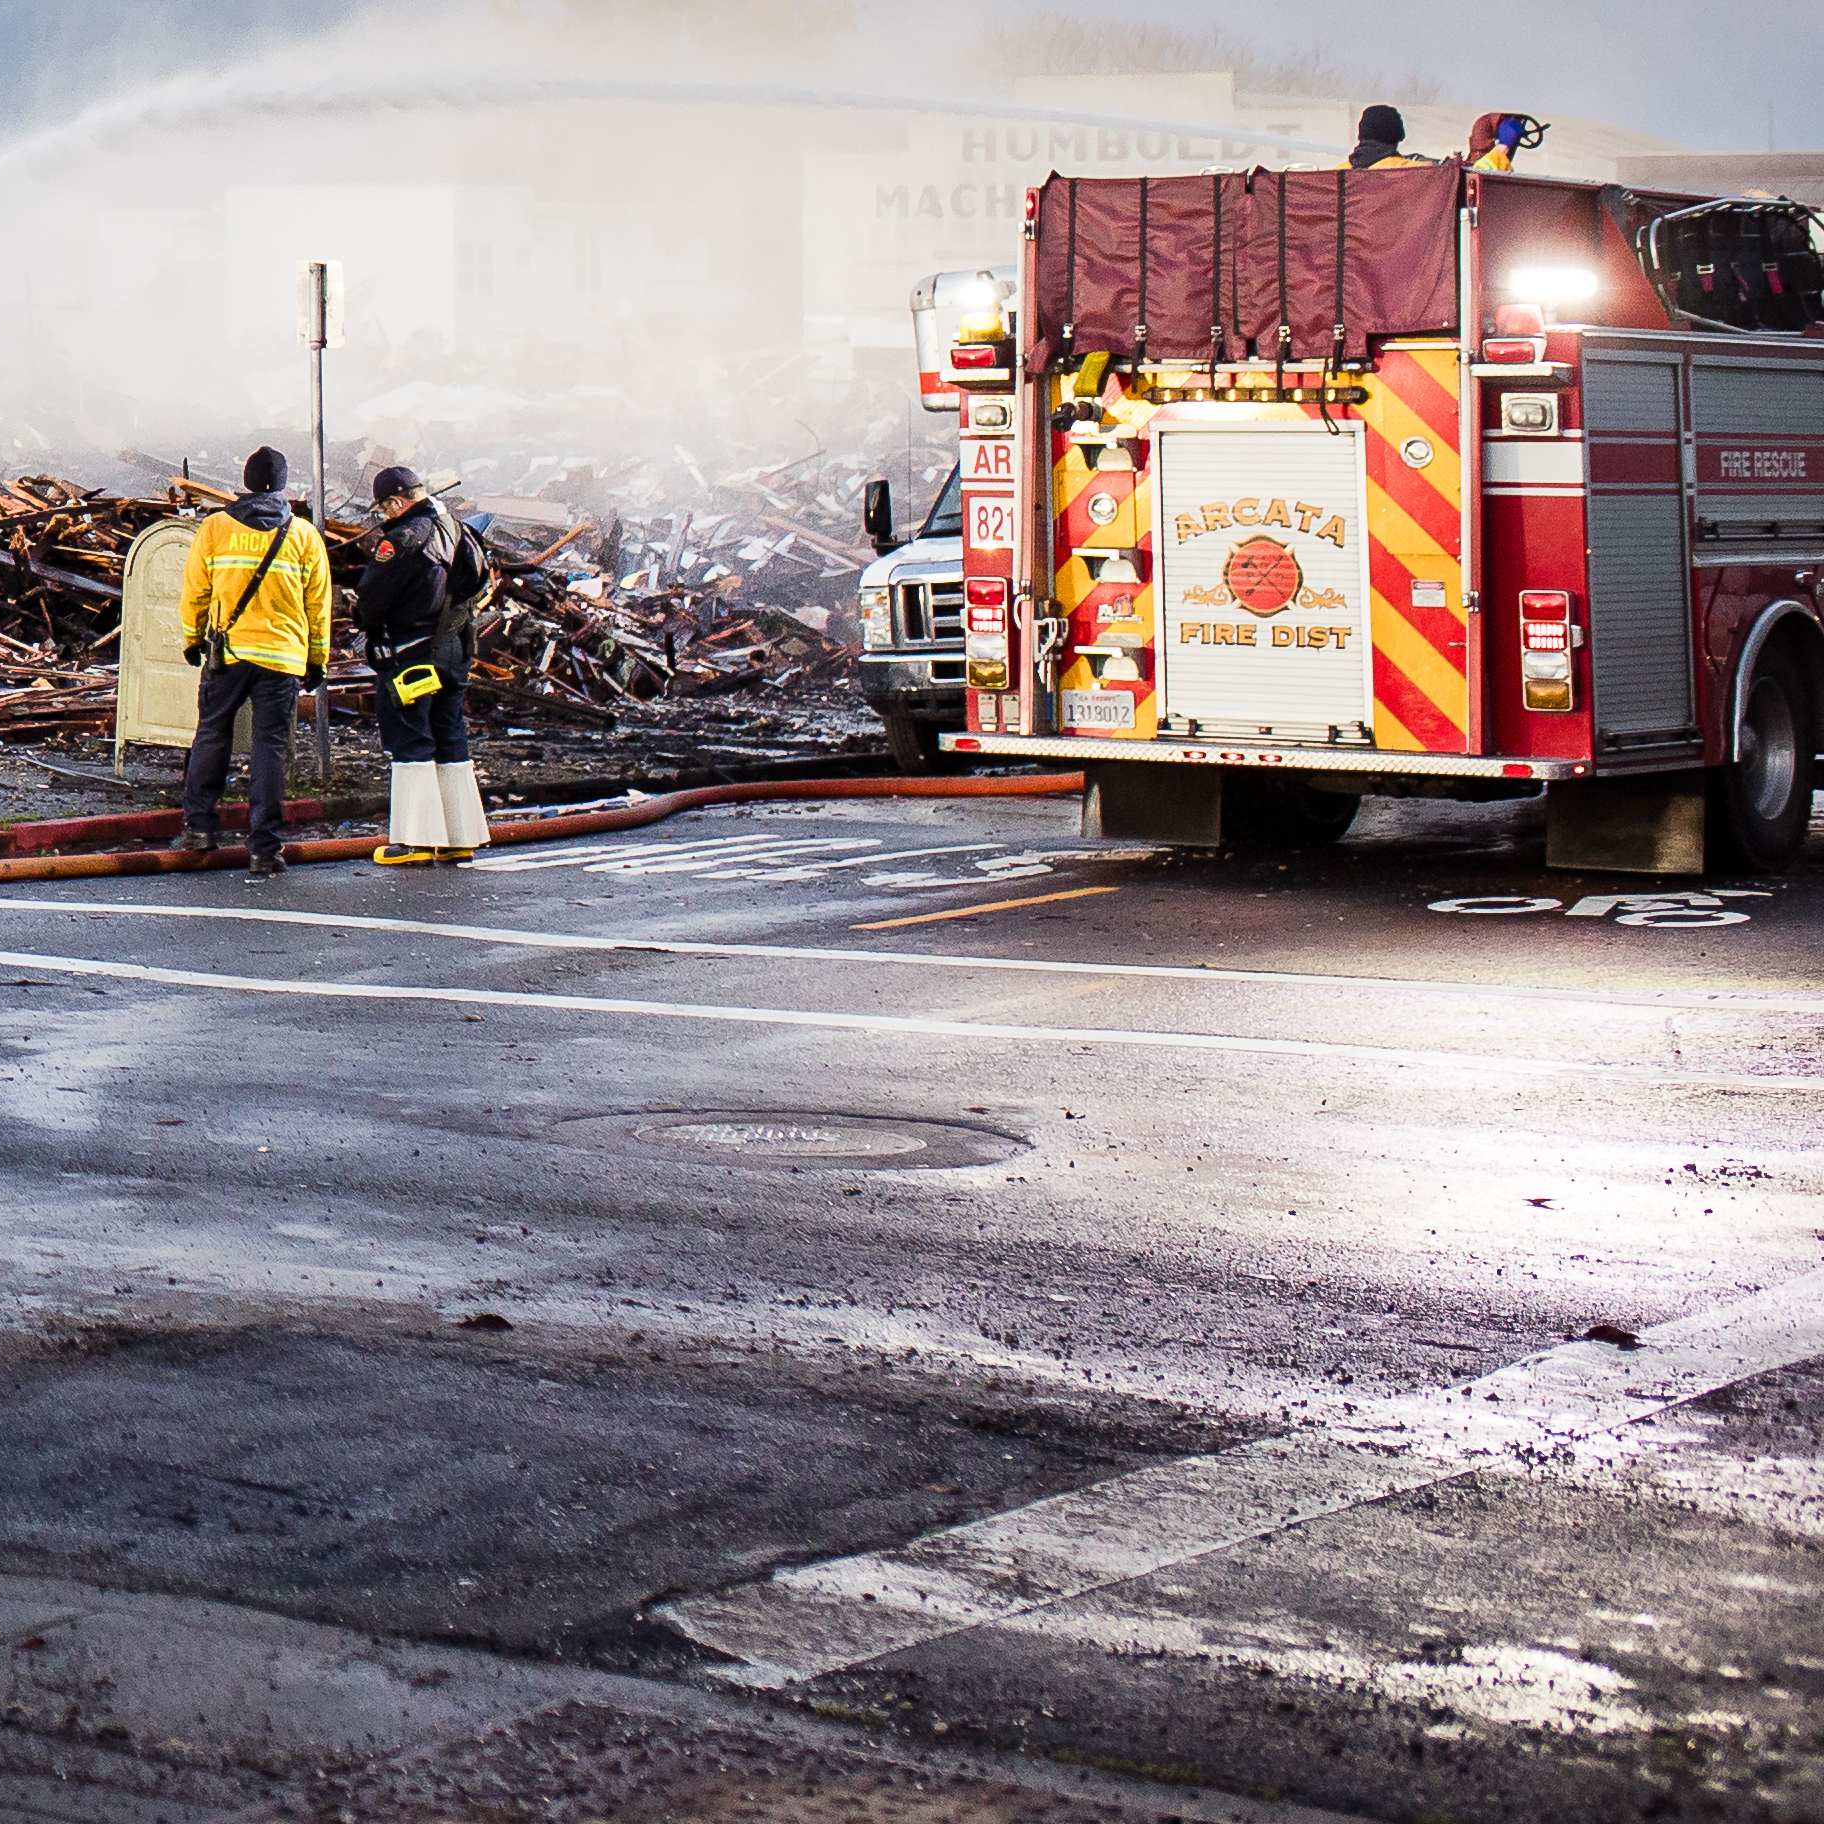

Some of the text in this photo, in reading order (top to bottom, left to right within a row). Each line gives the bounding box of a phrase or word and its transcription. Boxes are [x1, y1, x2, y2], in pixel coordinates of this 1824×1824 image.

[961, 123, 1304, 164] HUMBOLDT
[1720, 450, 1807, 477] FIRE RESCUE
[1174, 497, 1347, 549] ARCATA
[1180, 622, 1352, 650] FIRE DIST
